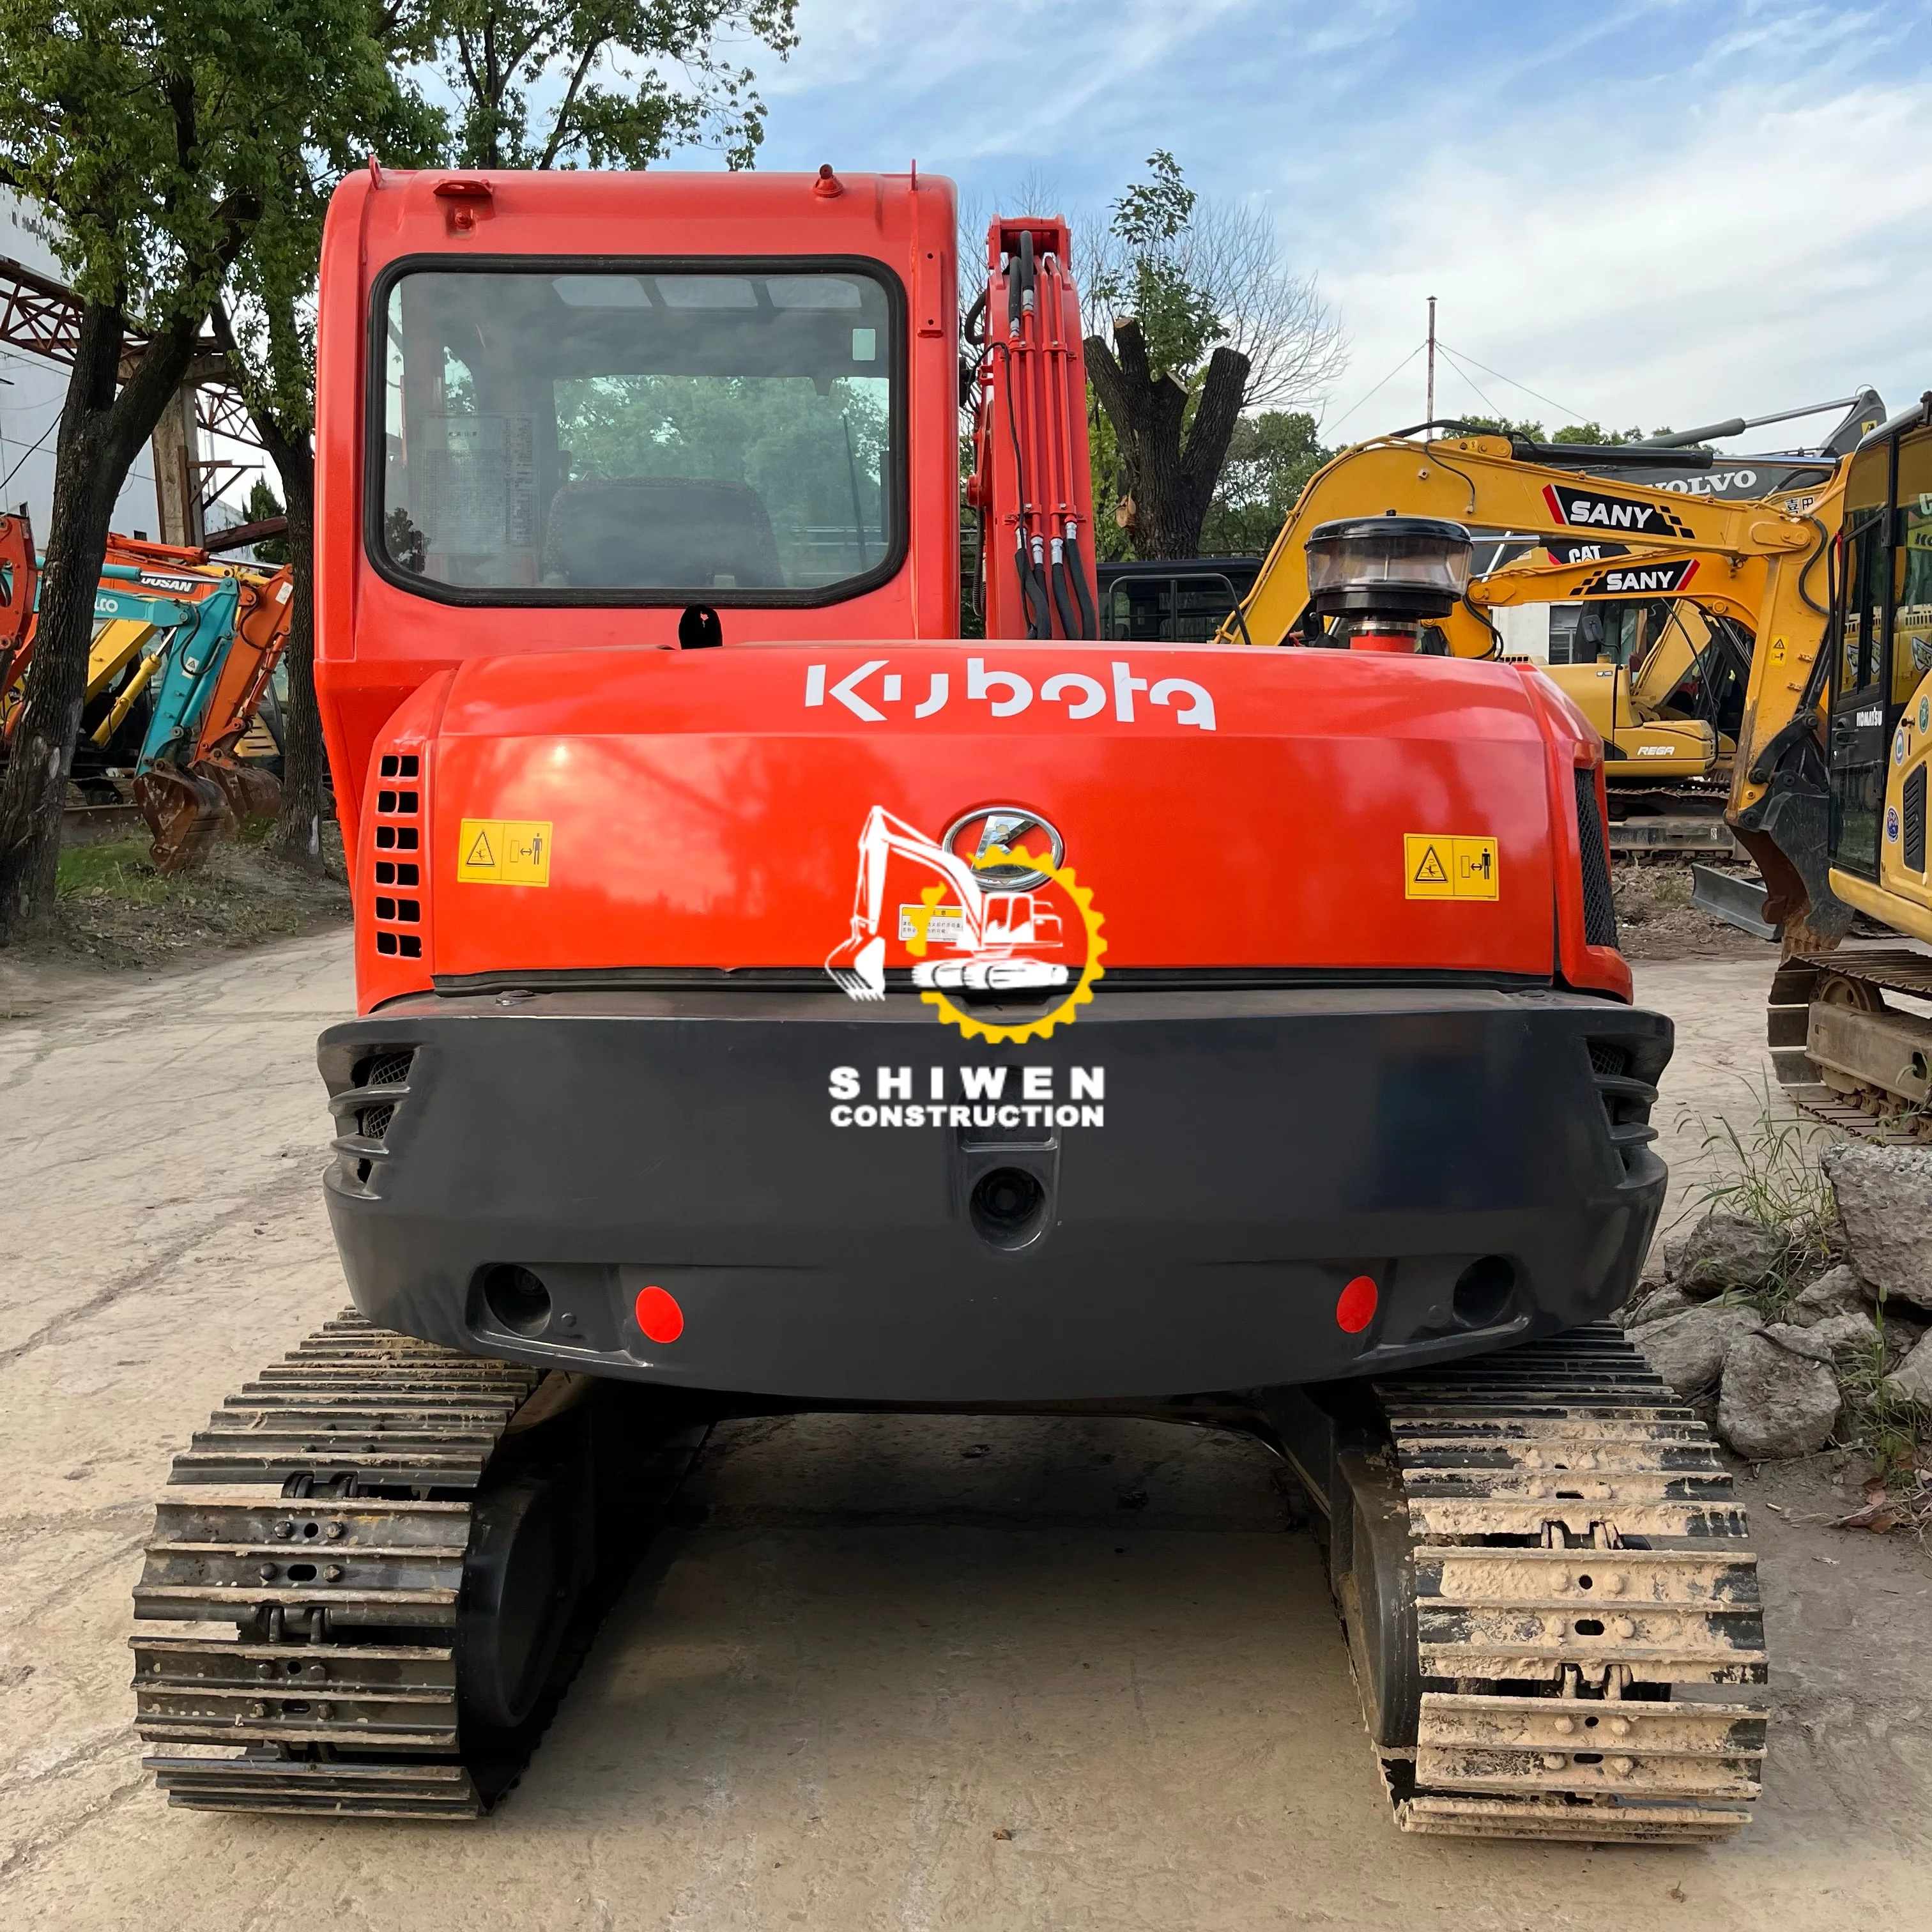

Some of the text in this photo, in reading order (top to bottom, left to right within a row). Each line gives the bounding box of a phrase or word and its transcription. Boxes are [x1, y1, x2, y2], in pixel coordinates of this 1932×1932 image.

[1644, 470, 1757, 495] OLVO
[1570, 500, 1653, 529] SANY
[1568, 545, 1601, 564] CAT
[1607, 571, 1674, 591] SANY
[804, 657, 1216, 731] Kubota
[1857, 707, 1882, 726] KOMATSU
[1637, 746, 1675, 755] REGA
